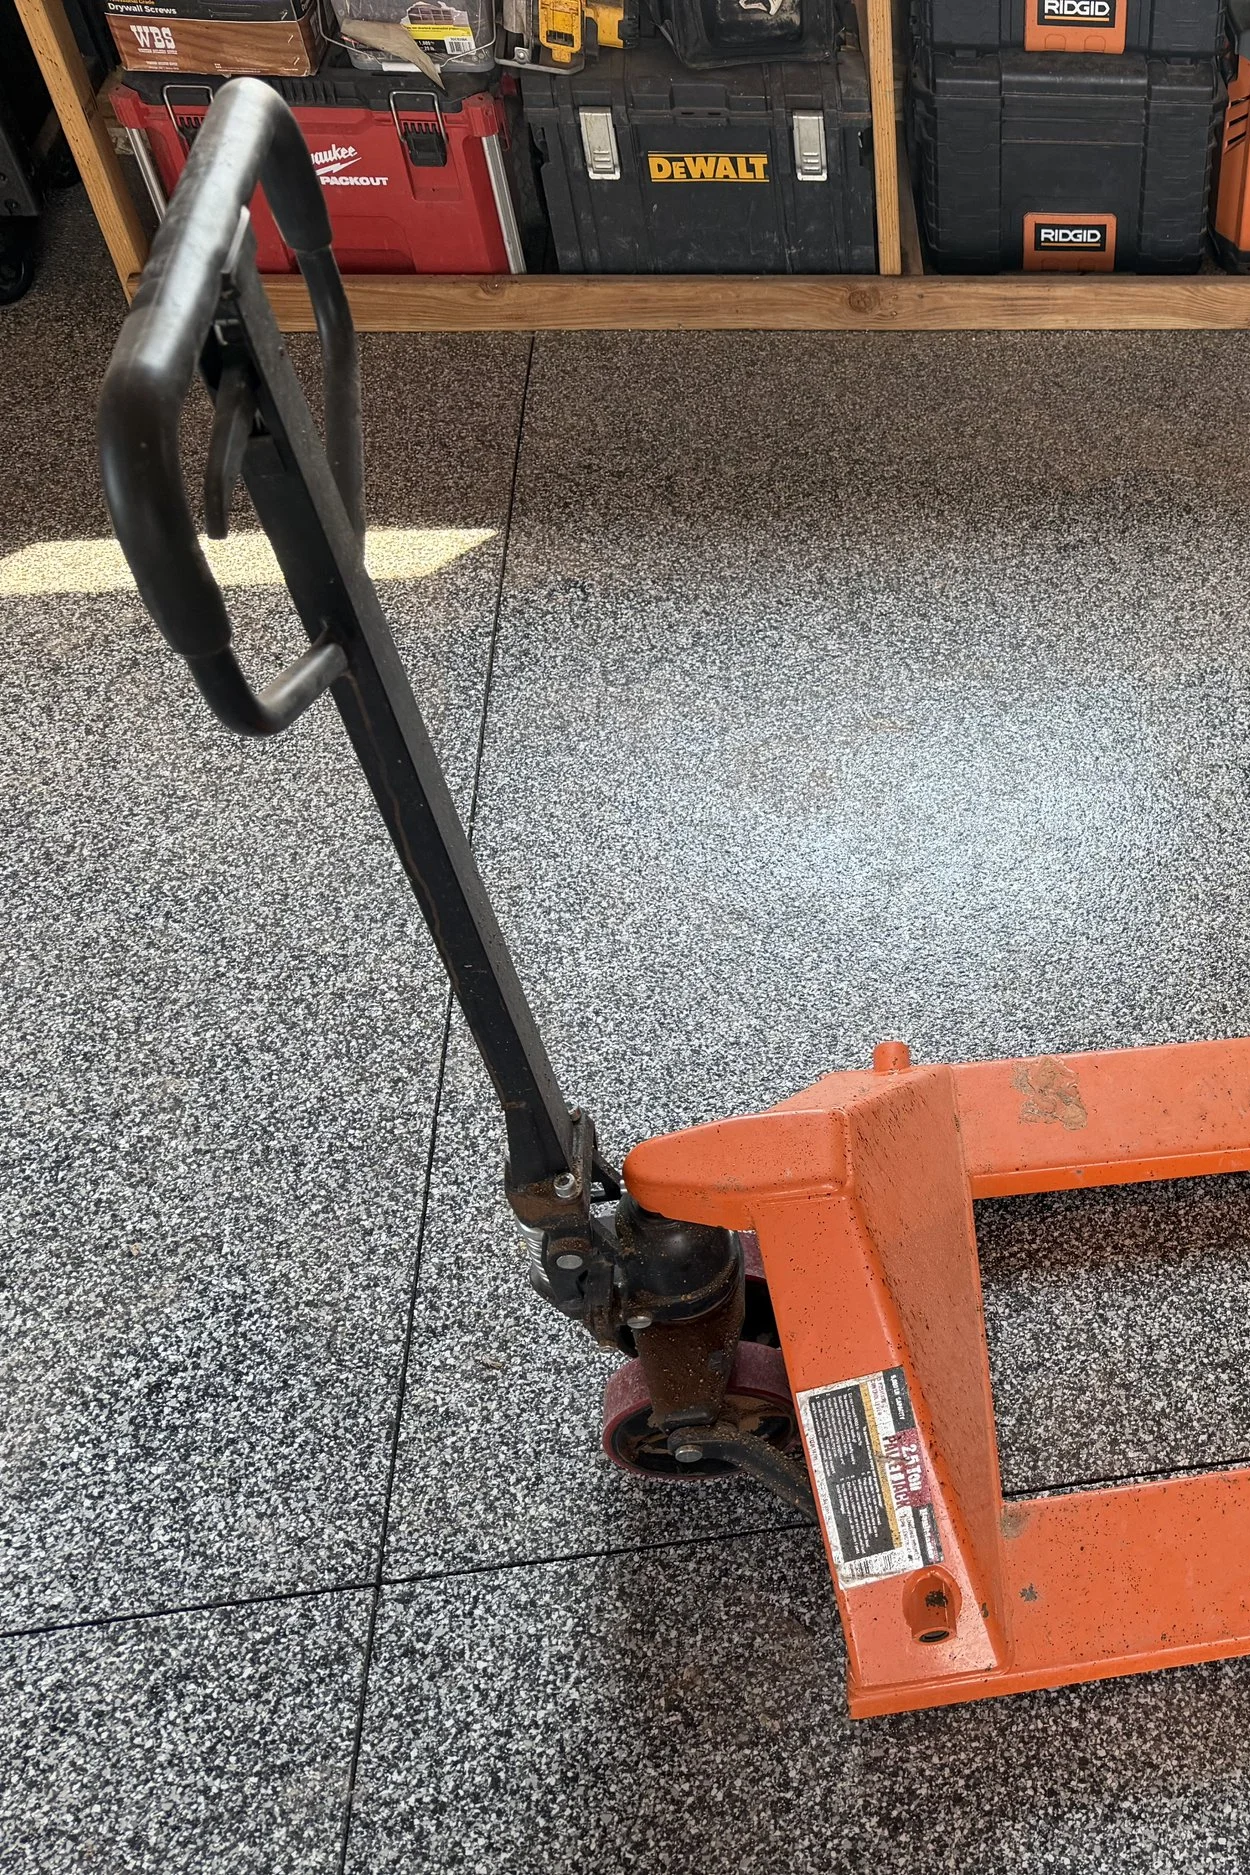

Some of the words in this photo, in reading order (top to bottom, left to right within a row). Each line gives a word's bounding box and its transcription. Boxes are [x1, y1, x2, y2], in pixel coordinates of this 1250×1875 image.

[107, 2, 144, 13] Drywall
[144, 5, 178, 15] Screws
[1044, 0, 1110, 16] RIDGID
[129, 24, 176, 49] WBS
[320, 176, 389, 186] PACKOUT
[1040, 228, 1102, 242] RIDGID
